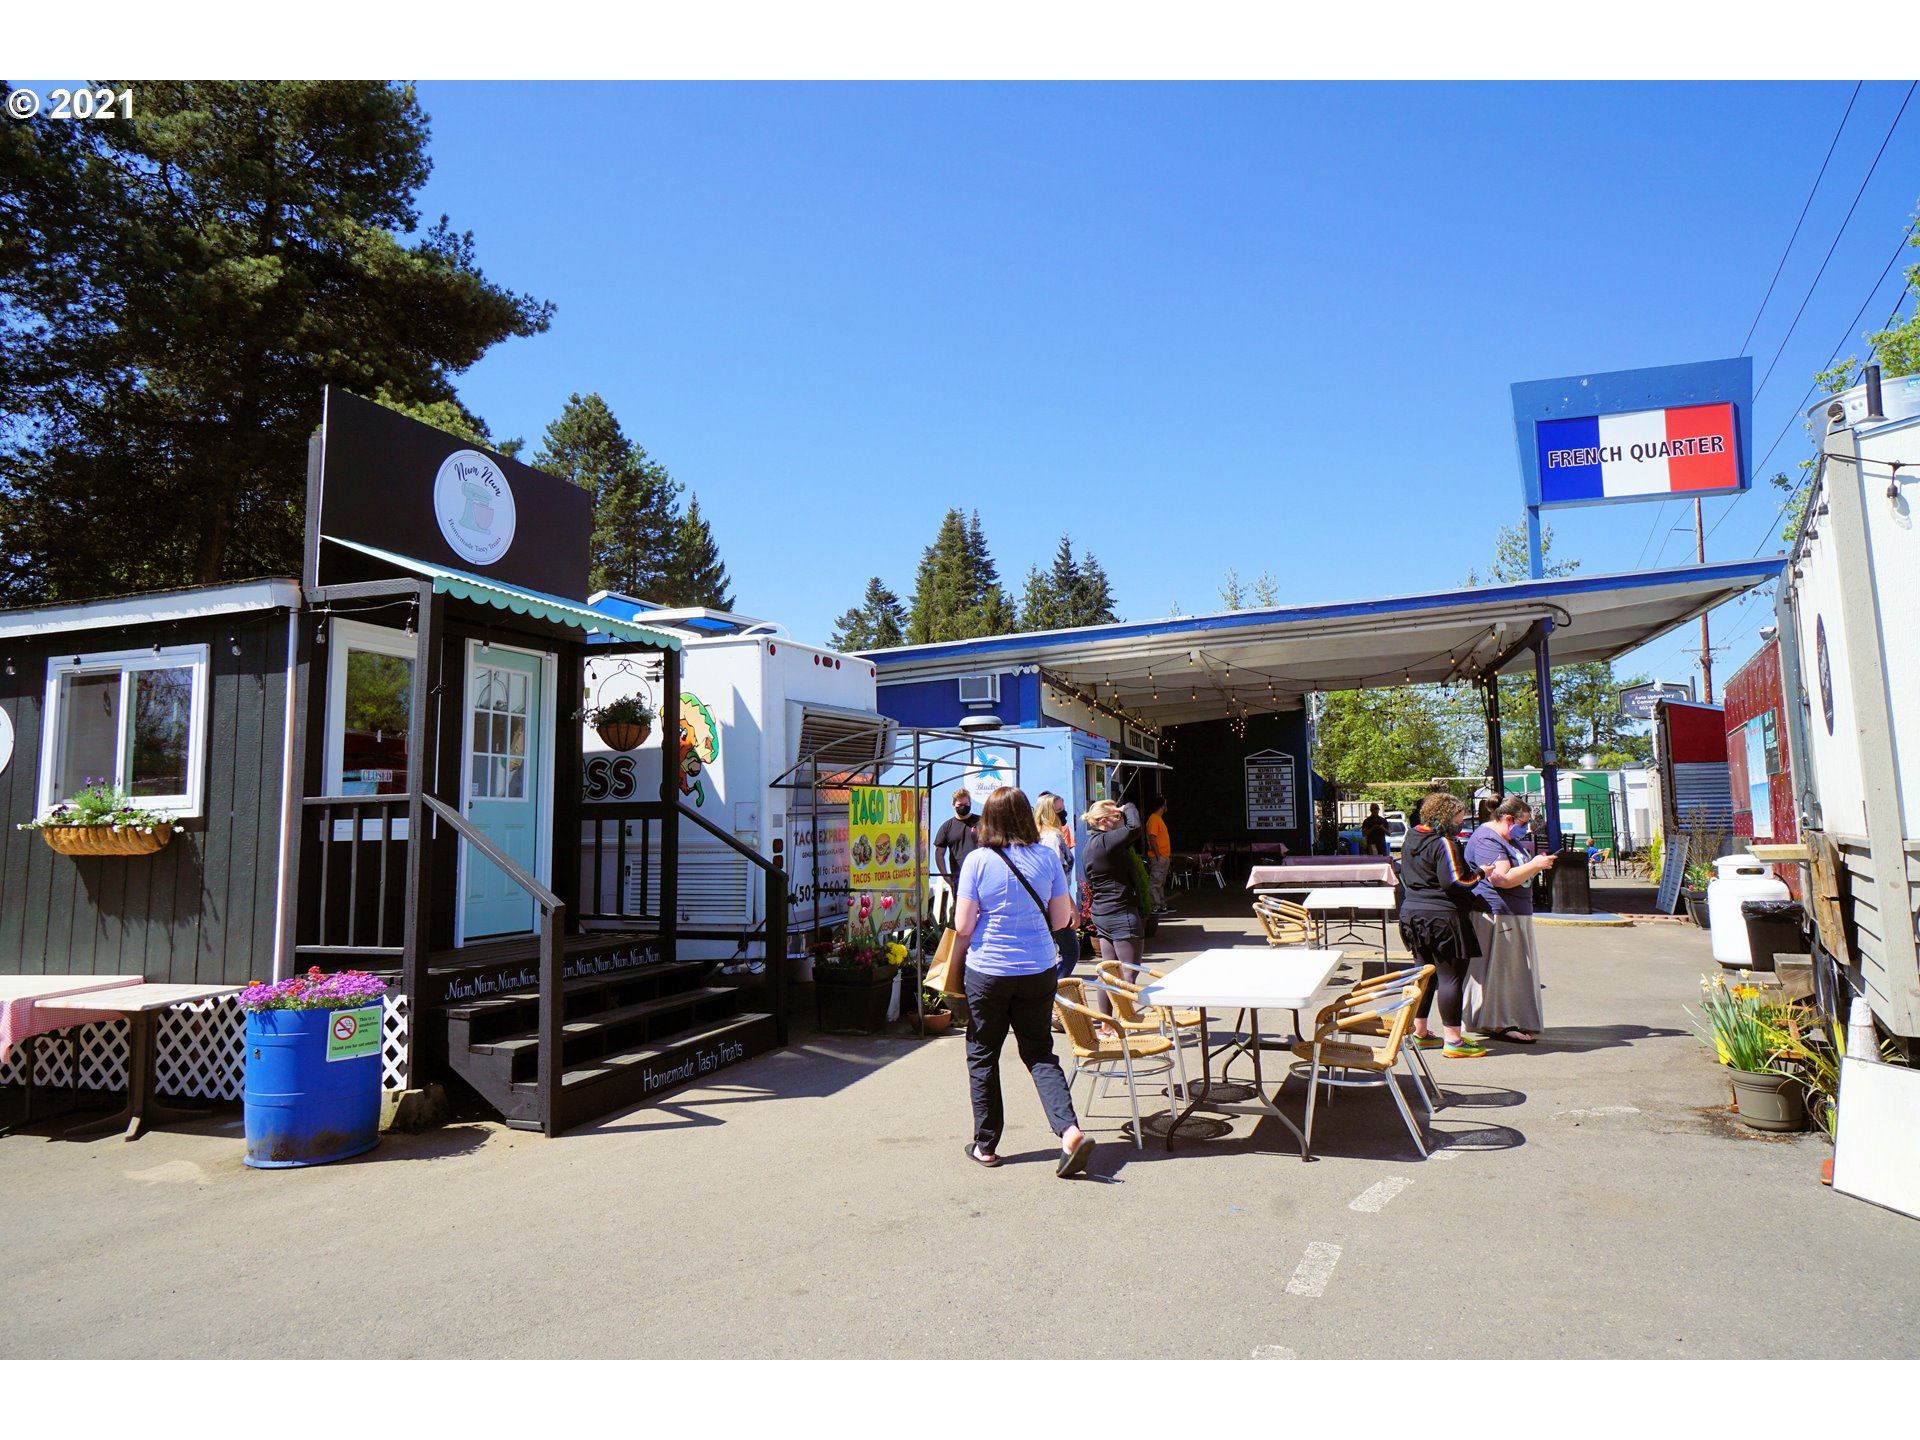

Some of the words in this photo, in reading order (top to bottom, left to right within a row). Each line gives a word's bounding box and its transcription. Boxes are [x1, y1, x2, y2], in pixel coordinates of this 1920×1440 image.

[1548, 446, 1622, 469] FRENCH
[1630, 435, 1725, 463] QUARTER
[454, 462, 479, 482] Num
[481, 466, 501, 497] Num
[362, 770, 392, 781] CLOSED
[583, 756, 637, 800] SS
[851, 788, 885, 826] TACO
[886, 788, 929, 826] EXPR
[853, 873, 871, 884] TACOS
[874, 871, 891, 881] TORTA
[643, 1058, 694, 1093] Homemade
[696, 1050, 718, 1073] Tasty
[718, 1040, 743, 1063] Treats
